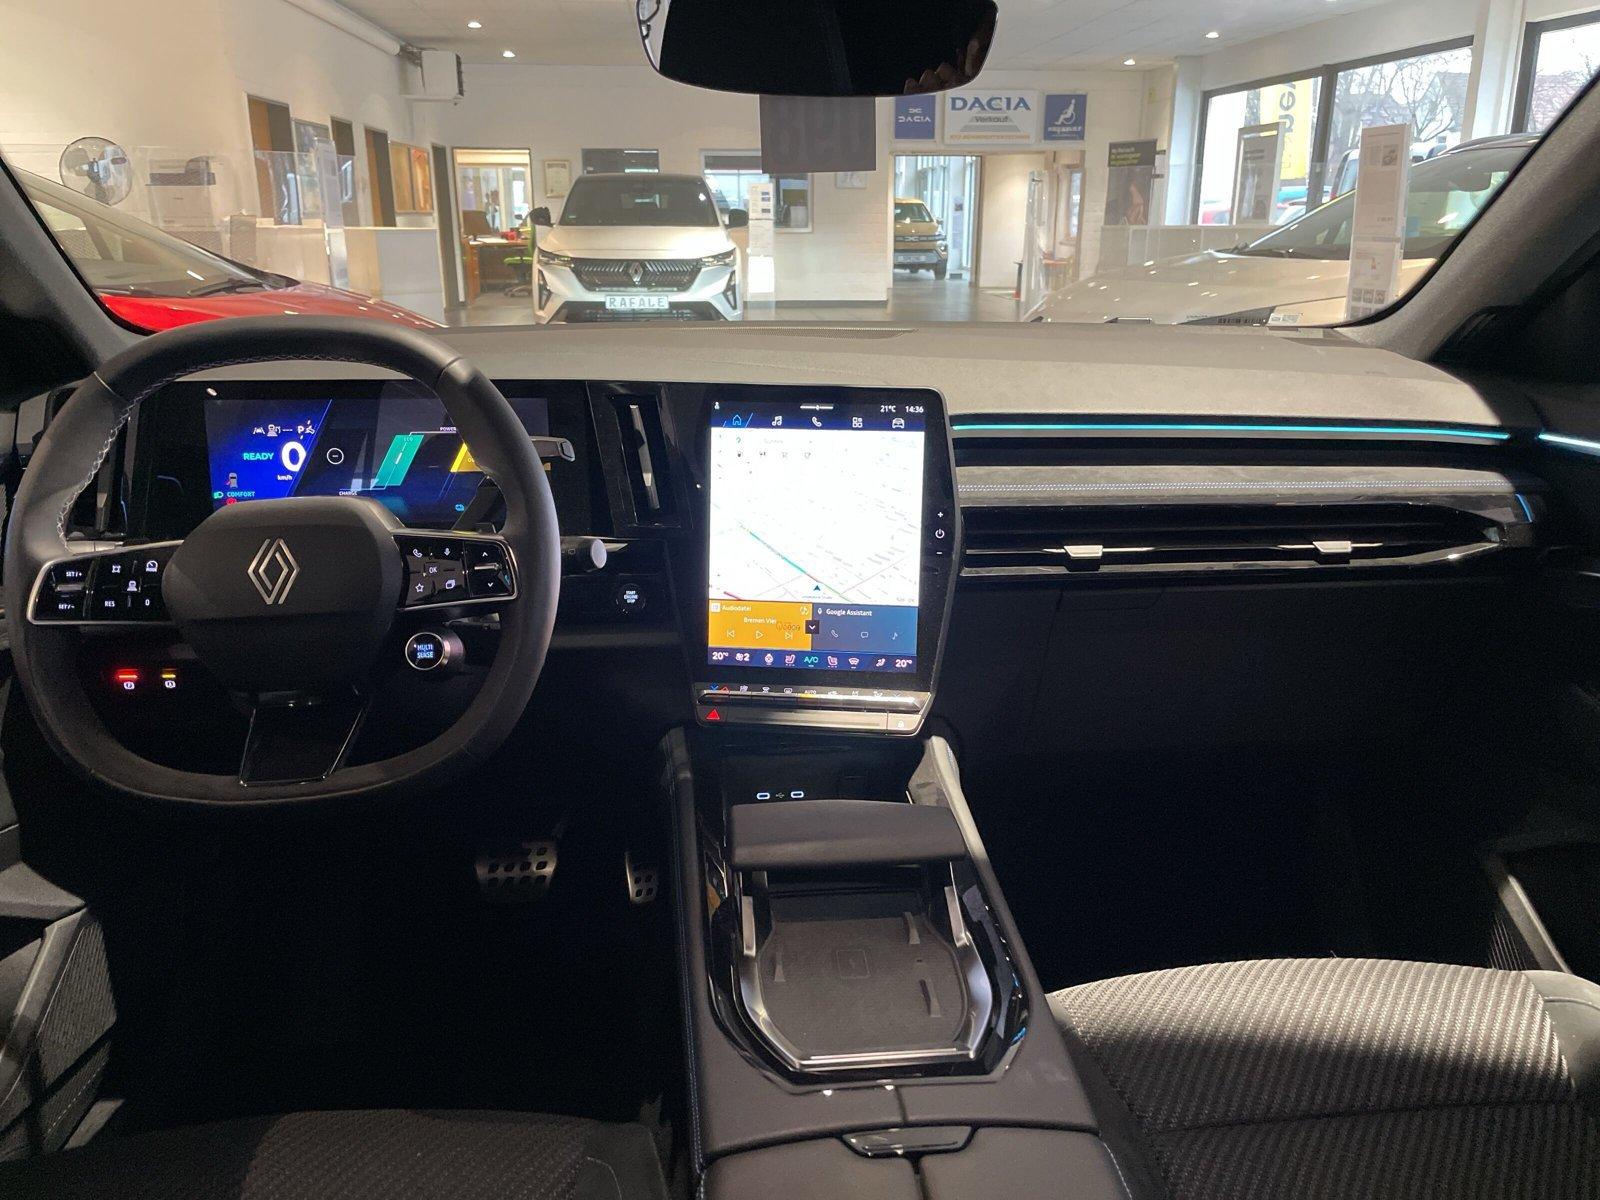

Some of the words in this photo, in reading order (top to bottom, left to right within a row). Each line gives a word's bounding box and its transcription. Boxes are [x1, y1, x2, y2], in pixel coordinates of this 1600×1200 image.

[950, 96, 1031, 111] DACIA
[974, 115, 1009, 123] Verkauf
[609, 297, 665, 308] RAFALE
[880, 404, 897, 413] 21°C
[905, 405, 924, 413] 14:36
[243, 452, 274, 461] READY
[281, 441, 307, 472] 0
[428, 565, 438, 574] OK
[104, 600, 116, 608] RES
[721, 604, 752, 613] Audiodatei
[825, 608, 846, 617] Google
[846, 609, 873, 617] Assistant
[743, 616, 765, 624] Bremen
[417, 643, 433, 651] MULTI
[416, 651, 434, 659] SENSE
